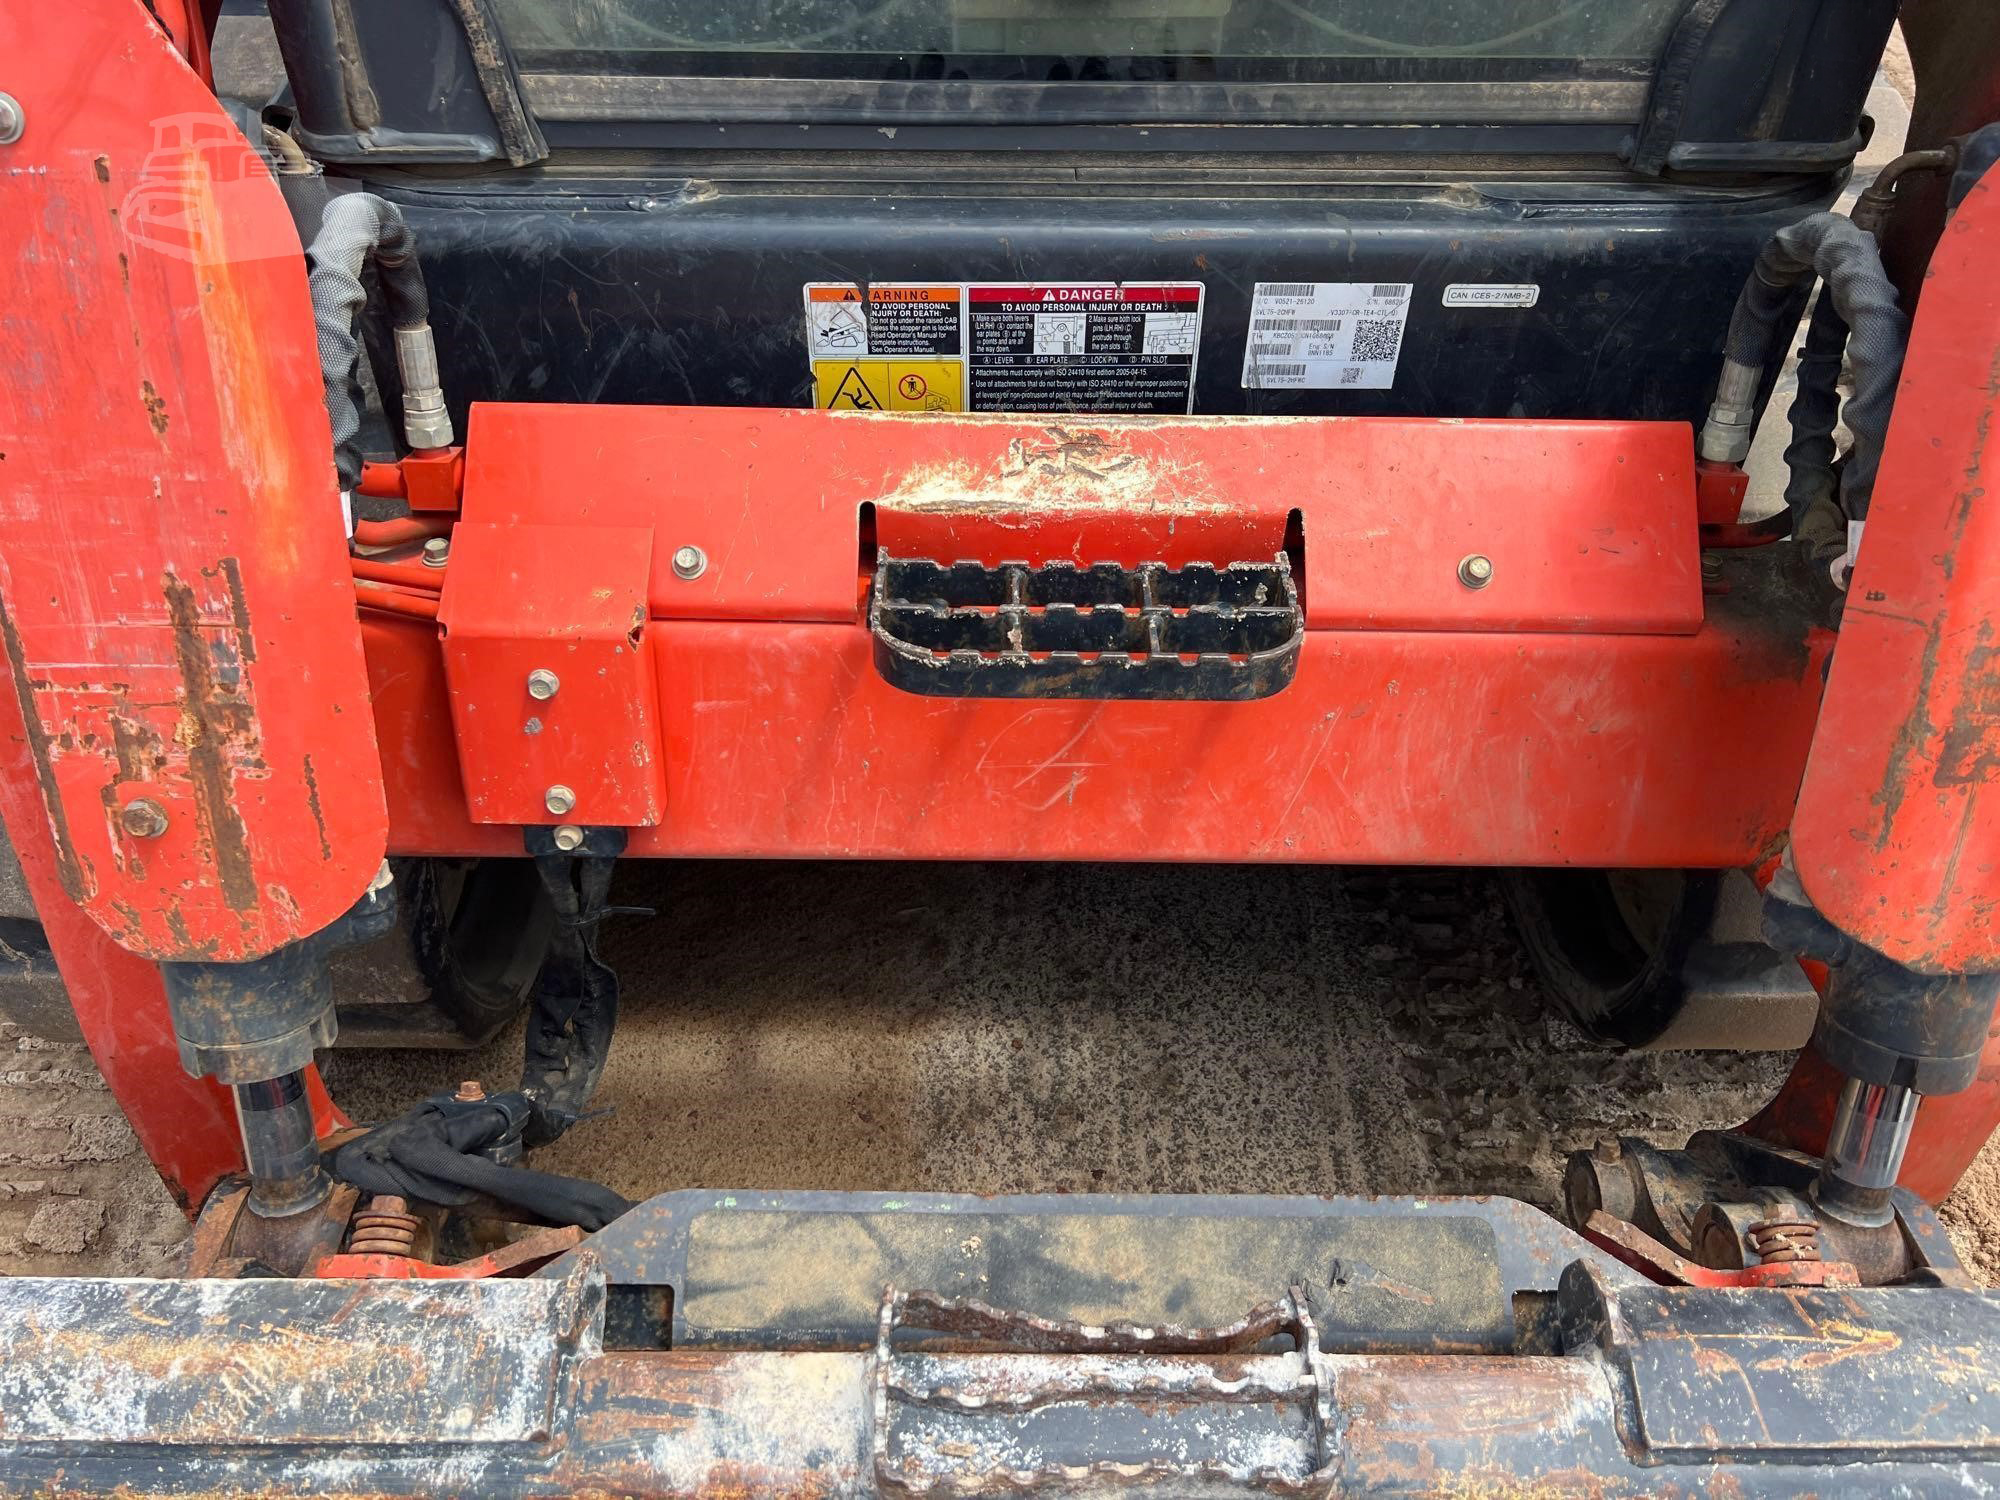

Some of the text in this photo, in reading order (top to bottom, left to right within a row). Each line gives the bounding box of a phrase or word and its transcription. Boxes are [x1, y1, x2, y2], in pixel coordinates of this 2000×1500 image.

[862, 290, 929, 300] ARNING
[1060, 290, 1124, 300] DANGER
[985, 346, 995, 354] way
[1024, 369, 1044, 377] comply
[1056, 380, 1076, 389] comply
[1134, 380, 1158, 389] improper
[1158, 380, 1188, 389] positioning
[1071, 392, 1083, 400] may
